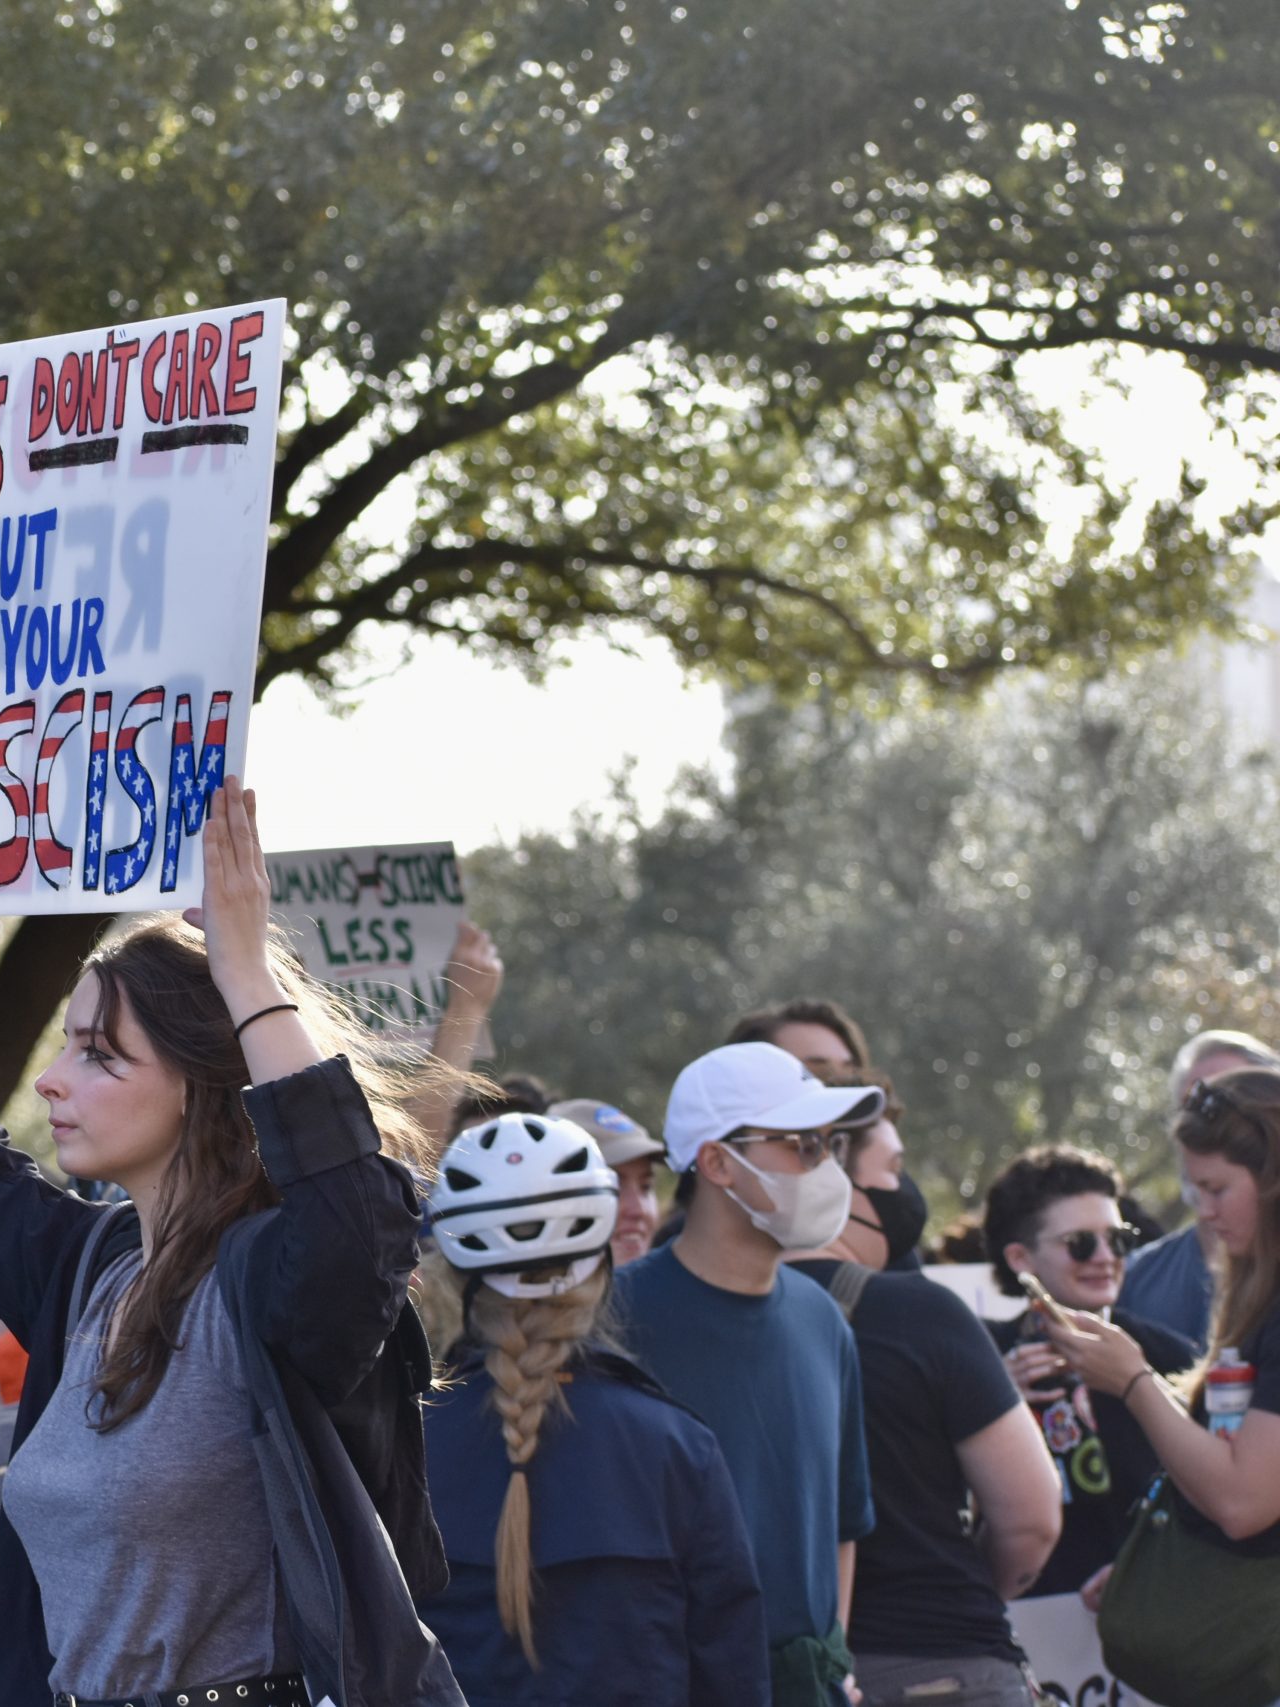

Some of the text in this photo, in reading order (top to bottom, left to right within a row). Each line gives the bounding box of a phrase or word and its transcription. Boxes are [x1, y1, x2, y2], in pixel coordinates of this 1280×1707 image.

[28, 329, 140, 443] DON'T
[140, 310, 265, 426] CARE
[0, 597, 107, 695] YOUR
[267, 854, 359, 907] UMANS
[316, 914, 415, 966] LESS
